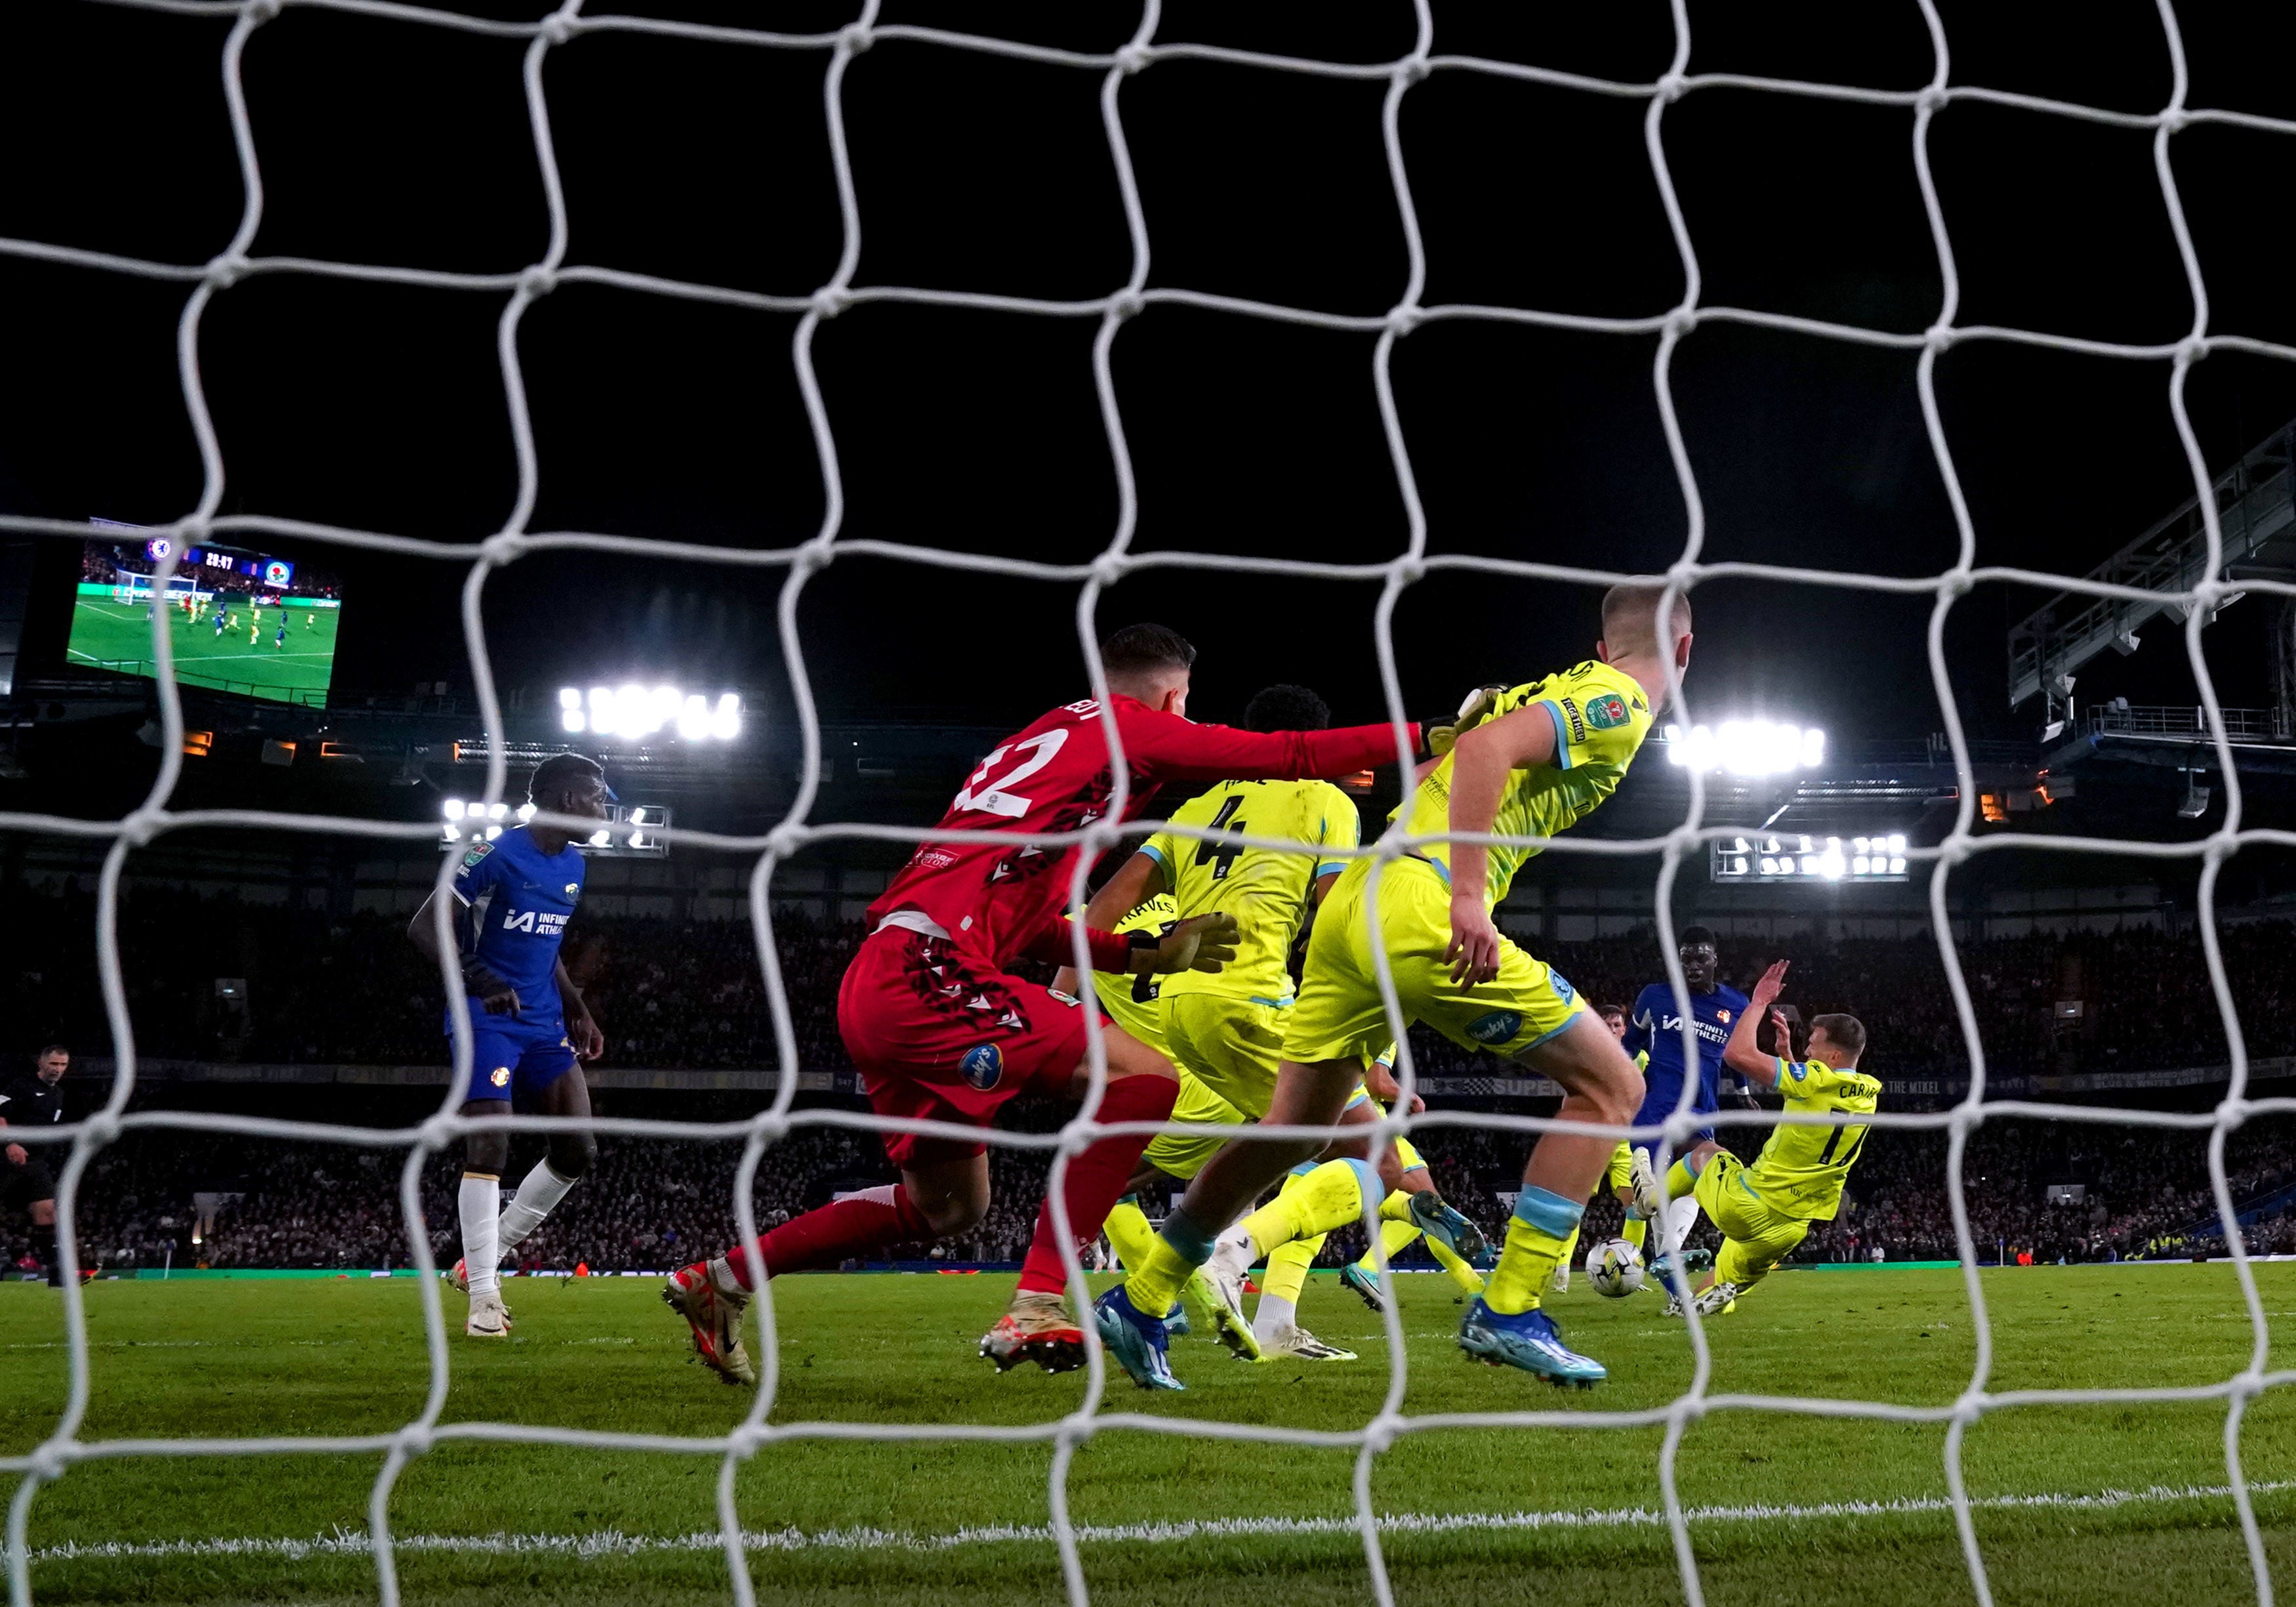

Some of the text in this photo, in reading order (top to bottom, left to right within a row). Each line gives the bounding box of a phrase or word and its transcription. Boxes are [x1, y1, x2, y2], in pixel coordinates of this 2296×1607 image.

[1563, 698, 1585, 741] TOGETHER
[1195, 795, 1246, 880] 4
[539, 913, 570, 925] INFINIT
[1889, 1081, 1939, 1094] THE MIKEL
